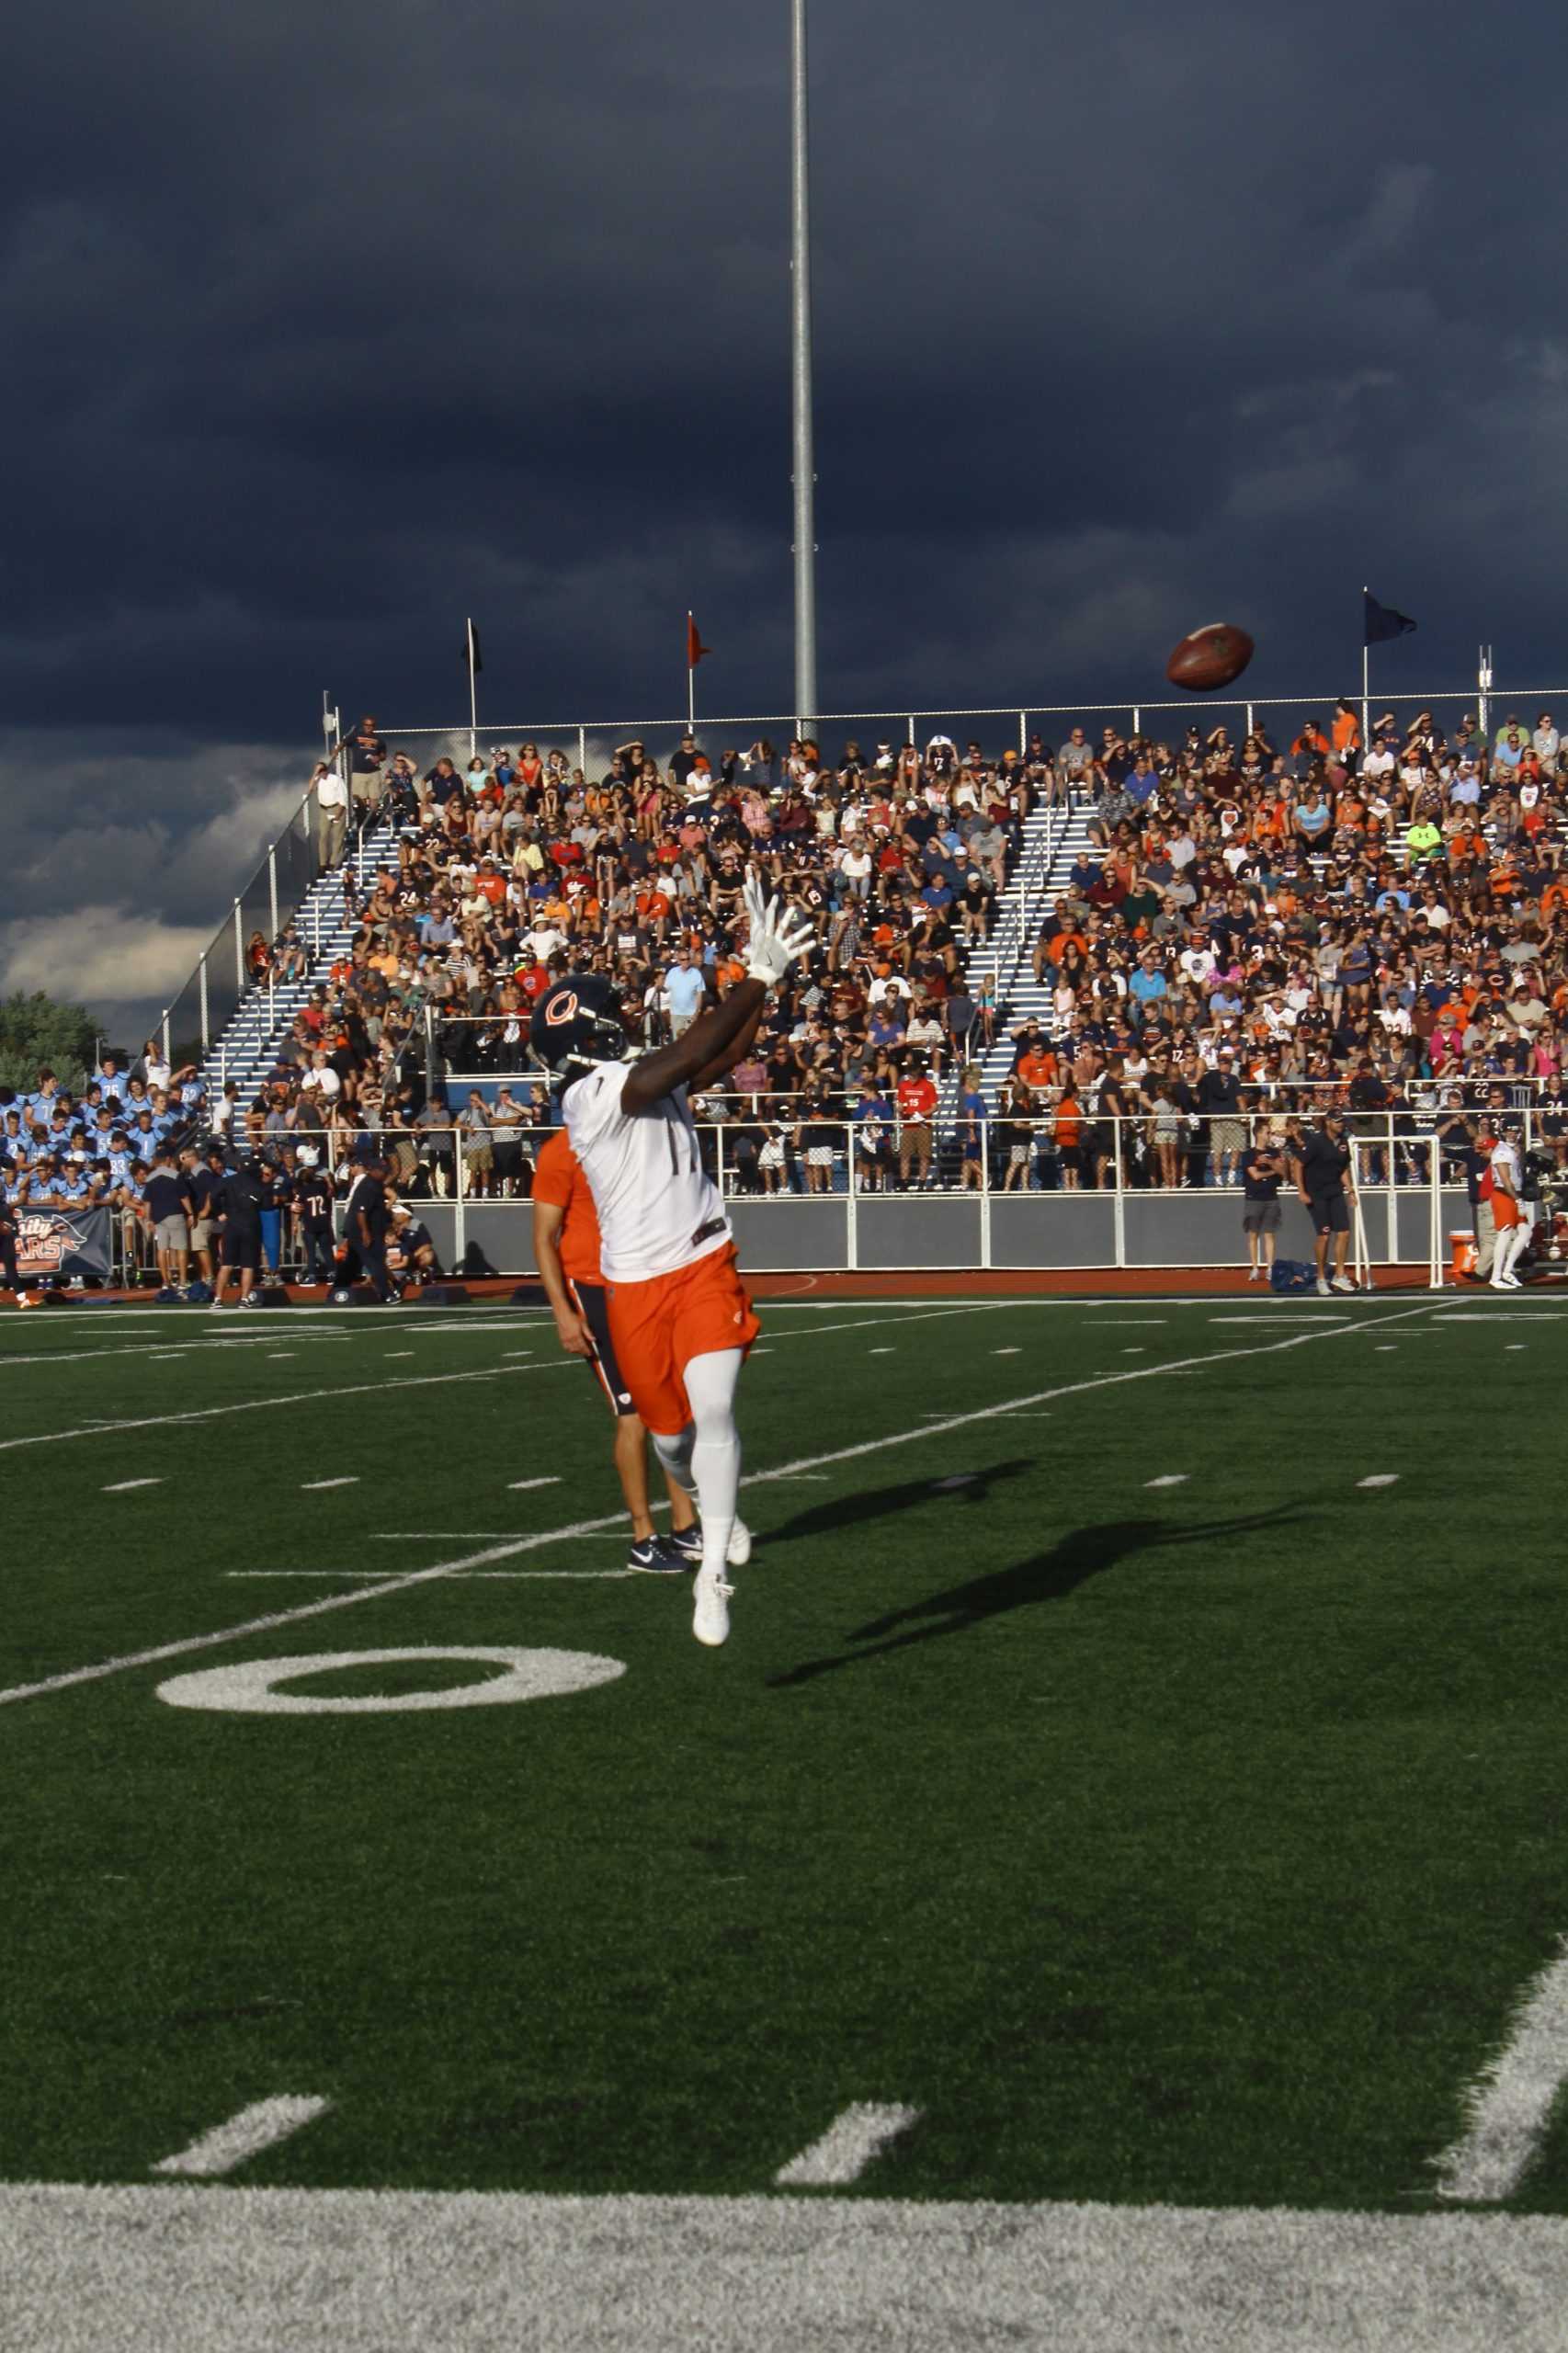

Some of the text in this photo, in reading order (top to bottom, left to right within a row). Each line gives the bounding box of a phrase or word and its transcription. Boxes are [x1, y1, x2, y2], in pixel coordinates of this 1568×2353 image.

[1420, 736, 1434, 752] 4
[400, 892, 416, 906] 24
[1172, 1050, 1184, 1063] 17
[1546, 1100, 1562, 1117] 34
[110, 1159, 125, 1175] 83
[307, 1195, 327, 1217] 72
[15, 1235, 60, 1259] ARS
